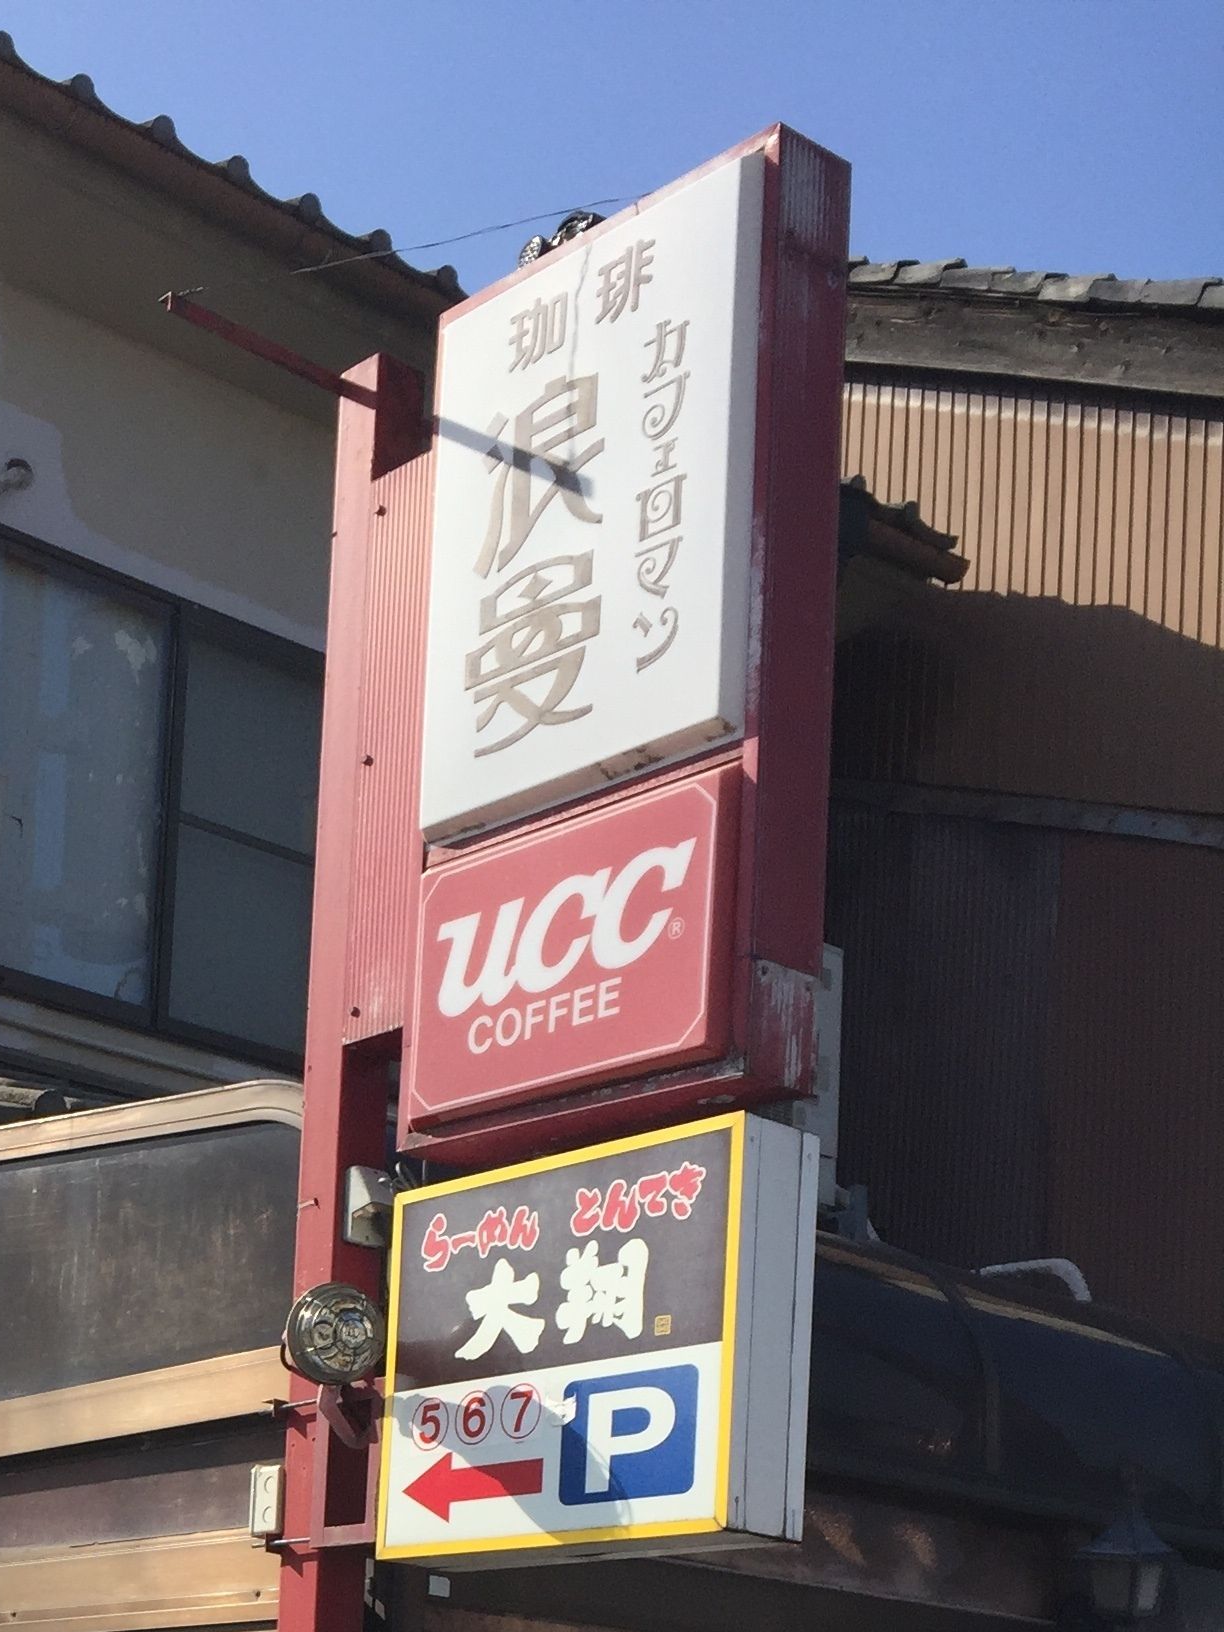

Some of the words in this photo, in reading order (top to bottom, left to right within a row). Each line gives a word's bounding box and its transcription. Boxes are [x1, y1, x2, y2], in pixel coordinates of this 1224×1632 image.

[509, 239, 656, 373] 珈琲
[467, 976, 622, 1055] COFFEE
[421, 1205, 540, 1272] らーめん
[570, 1161, 707, 1237] とんてき
[454, 1238, 649, 1361] 大翔
[584, 1385, 676, 1494] P
